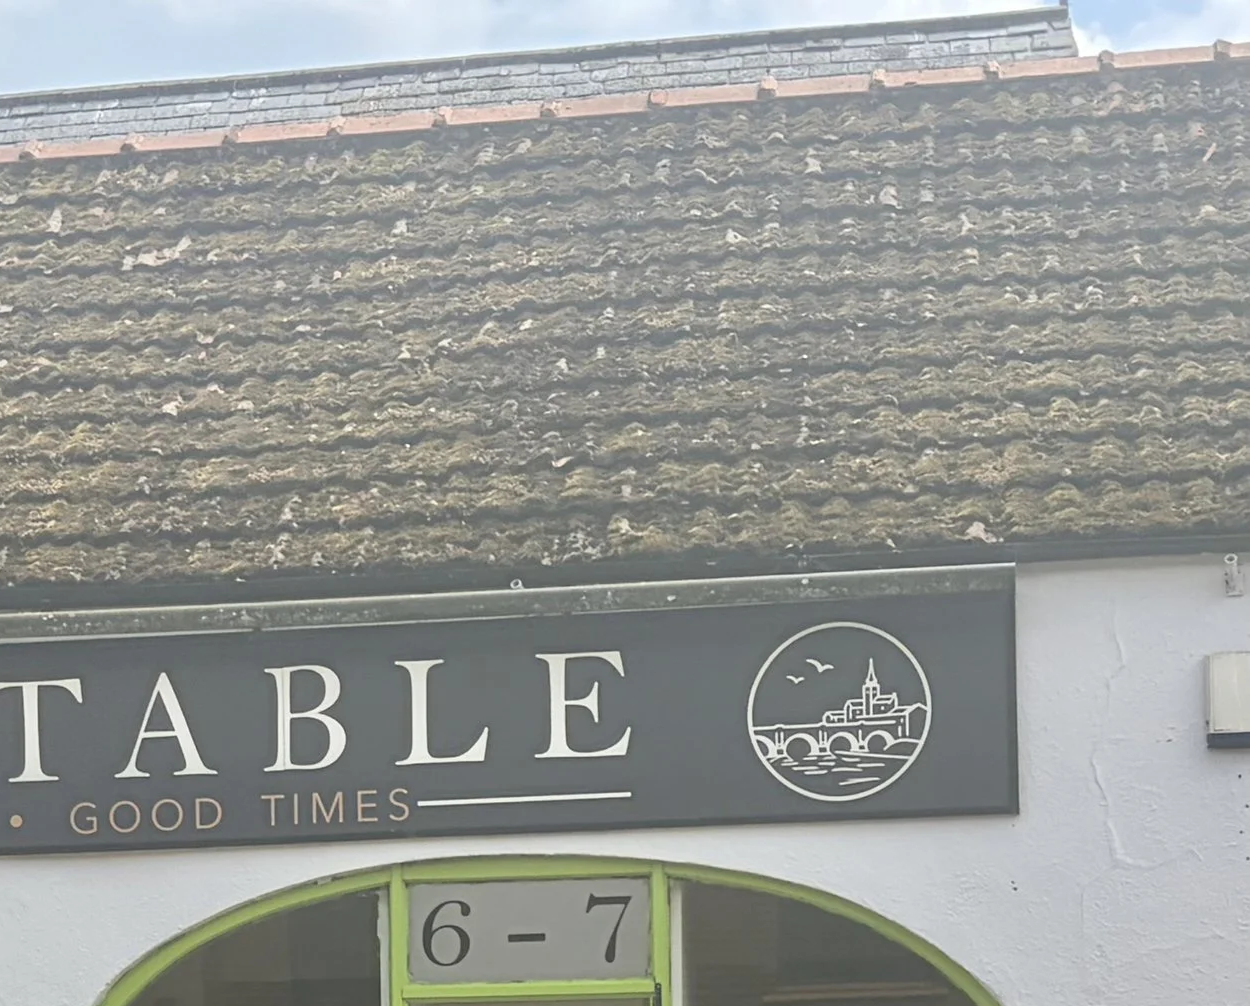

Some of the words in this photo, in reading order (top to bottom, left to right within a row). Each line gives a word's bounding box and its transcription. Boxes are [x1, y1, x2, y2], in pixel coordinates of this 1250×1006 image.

[69, 797, 223, 835] GOOD
[261, 787, 411, 827] TIMES
[422, 900, 472, 967] 6
[585, 893, 633, 964] 7
